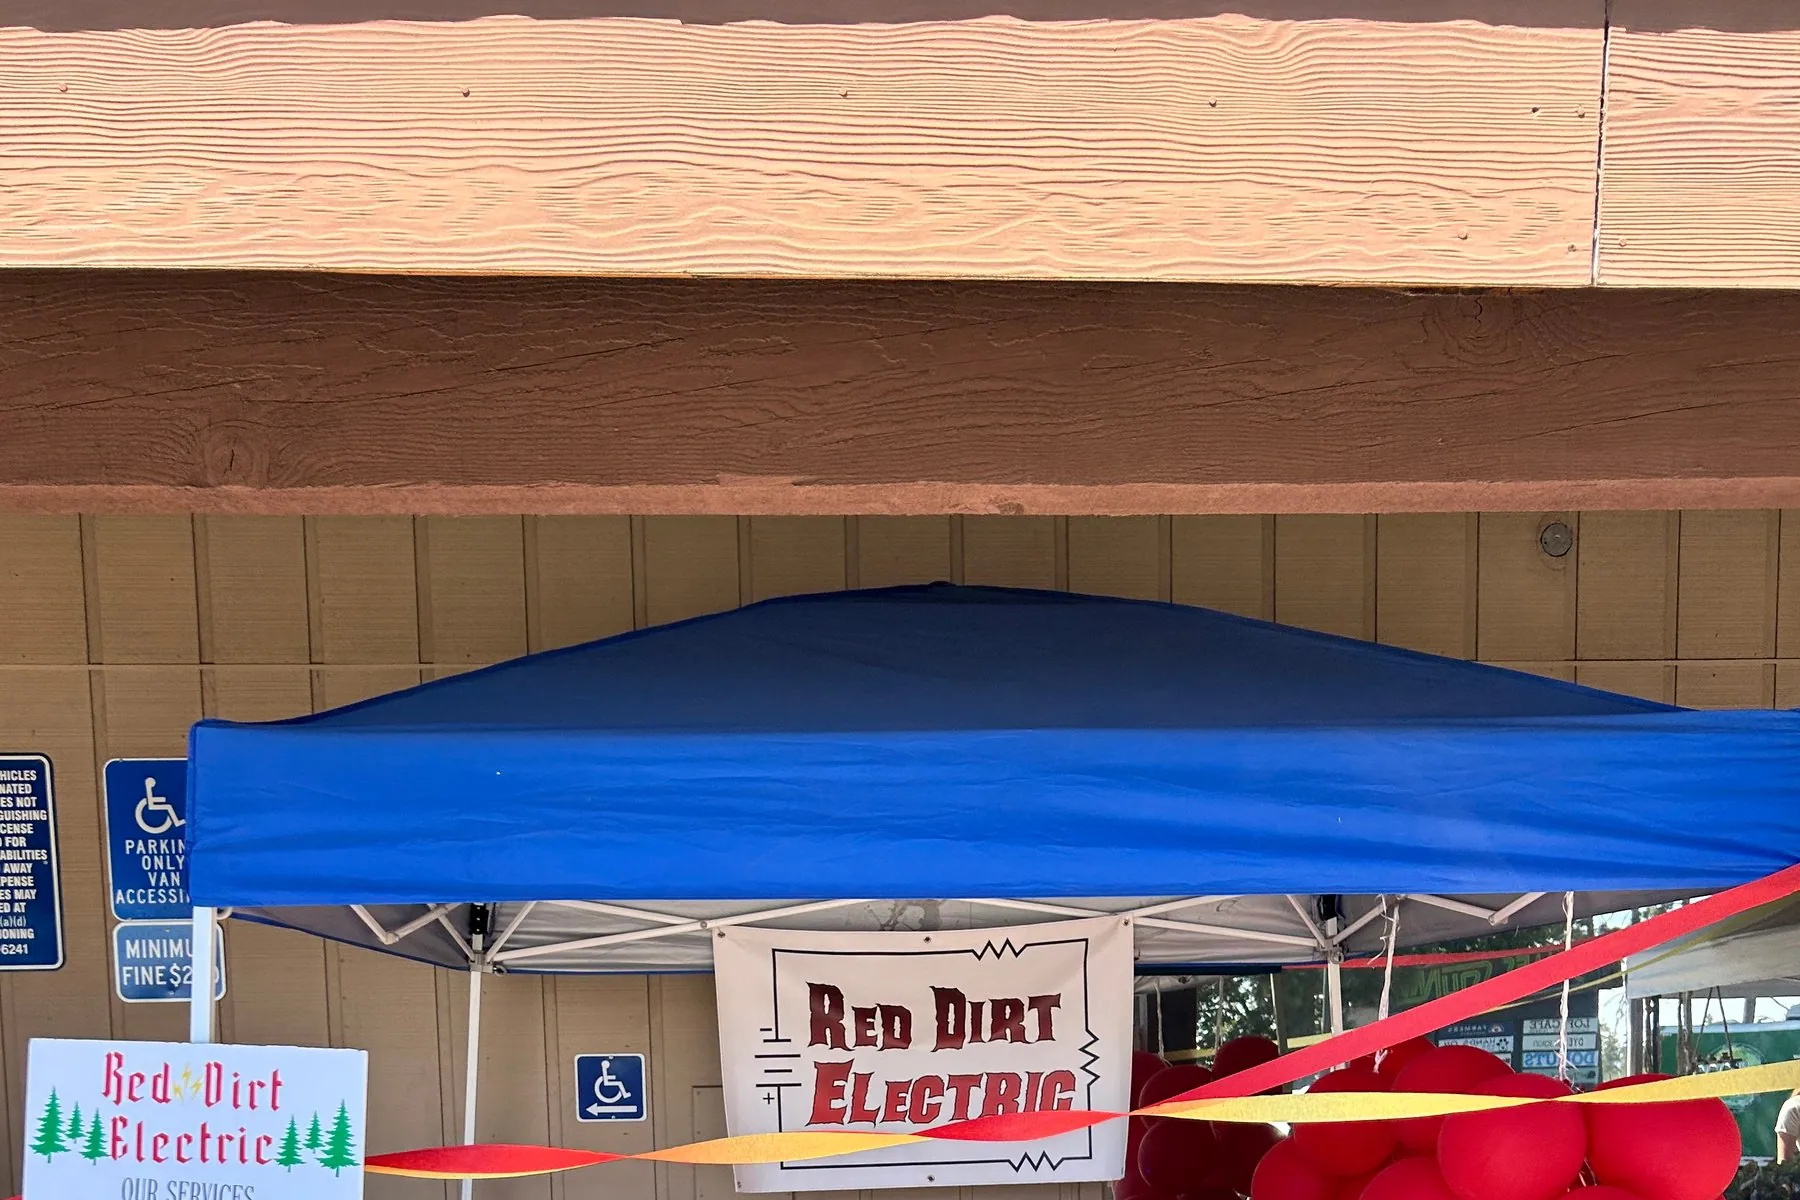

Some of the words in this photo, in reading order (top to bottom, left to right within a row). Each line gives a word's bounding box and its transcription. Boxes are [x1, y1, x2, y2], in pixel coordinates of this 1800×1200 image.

[0, 770, 37, 781] HICLES
[0, 783, 33, 794] NATED
[16, 796, 37, 808] NOT
[0, 809, 48, 821] GUISHING
[0, 823, 34, 834] CENSE
[5, 836, 27, 848] FOR
[125, 838, 187, 855] PARKIN
[0, 849, 48, 861] ABILITIES
[3, 862, 33, 874] AWAY
[142, 855, 185, 871] ONLY
[0, 876, 35, 887] PENSE
[148, 871, 181, 887] VAN
[14, 889, 37, 900] MAY
[116, 888, 190, 905] ACCESSI
[13, 902, 26, 913] AT
[0, 915, 27, 927] (a)(d)
[0, 928, 35, 939] ONING
[0, 943, 29, 955] 6241
[125, 938, 193, 959] MINIMU
[122, 965, 167, 986] FINE
[805, 981, 912, 1052] RED
[929, 985, 1062, 1053] DIRT
[102, 1051, 172, 1106] Red
[204, 1060, 284, 1112] Dirt
[805, 1058, 1077, 1128] ELECTRIC
[111, 1115, 273, 1166] Electric
